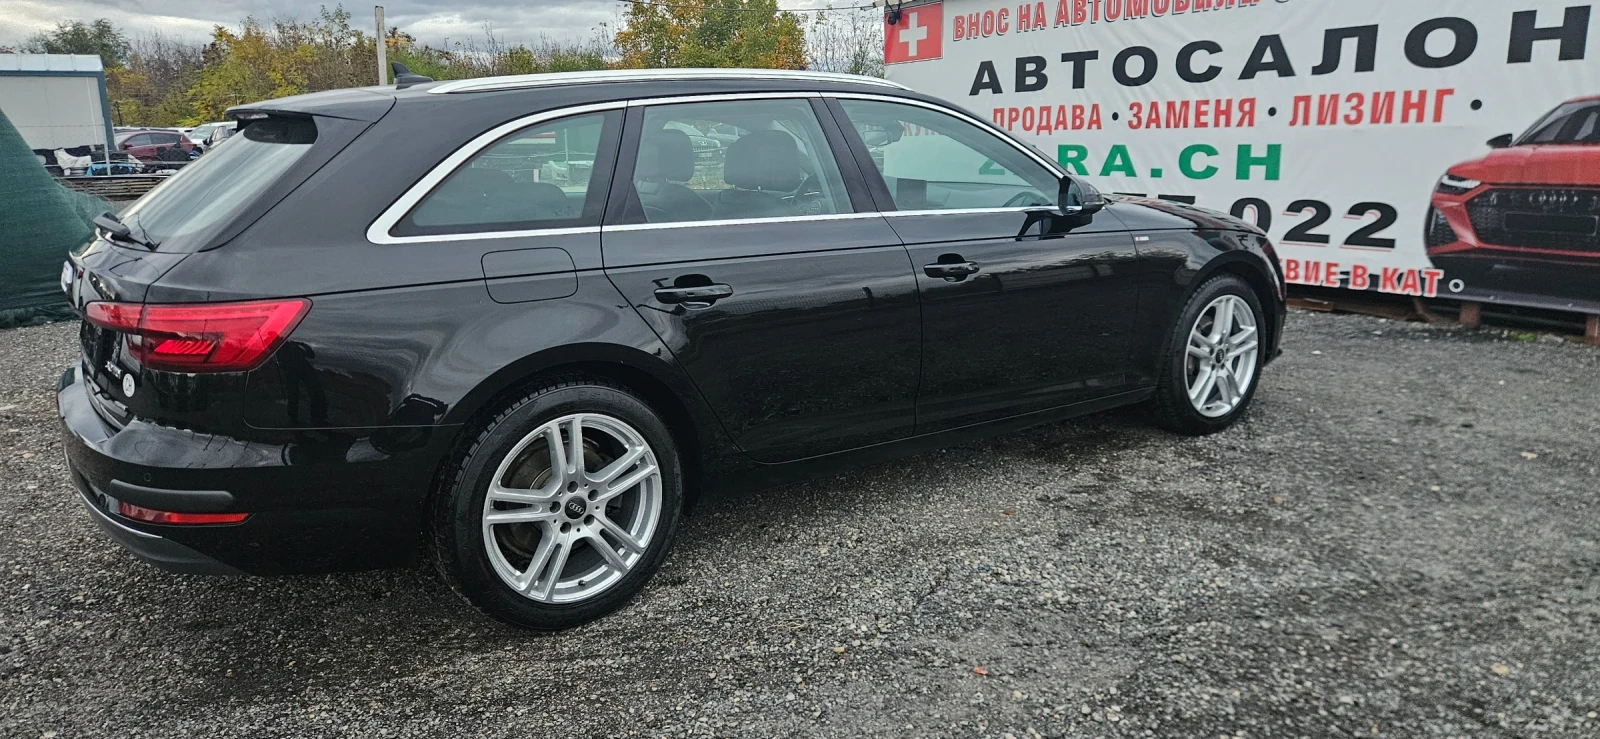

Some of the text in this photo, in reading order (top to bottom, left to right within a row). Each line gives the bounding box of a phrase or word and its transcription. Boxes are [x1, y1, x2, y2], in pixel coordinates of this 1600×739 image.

[953, 8, 1010, 41] ВНОС
[1016, 6, 1048, 33] НА
[969, 5, 1592, 96] АВТОСАЛОН
[993, 104, 1103, 136] ПРОДАВА
[1128, 97, 1256, 130] ЗАМЕНЯ
[1289, 88, 1455, 127] ЛИЗИНГ
[978, 144, 1282, 181] ZRA.CH
[1279, 257, 1444, 298] ВИЕ В КАТ
